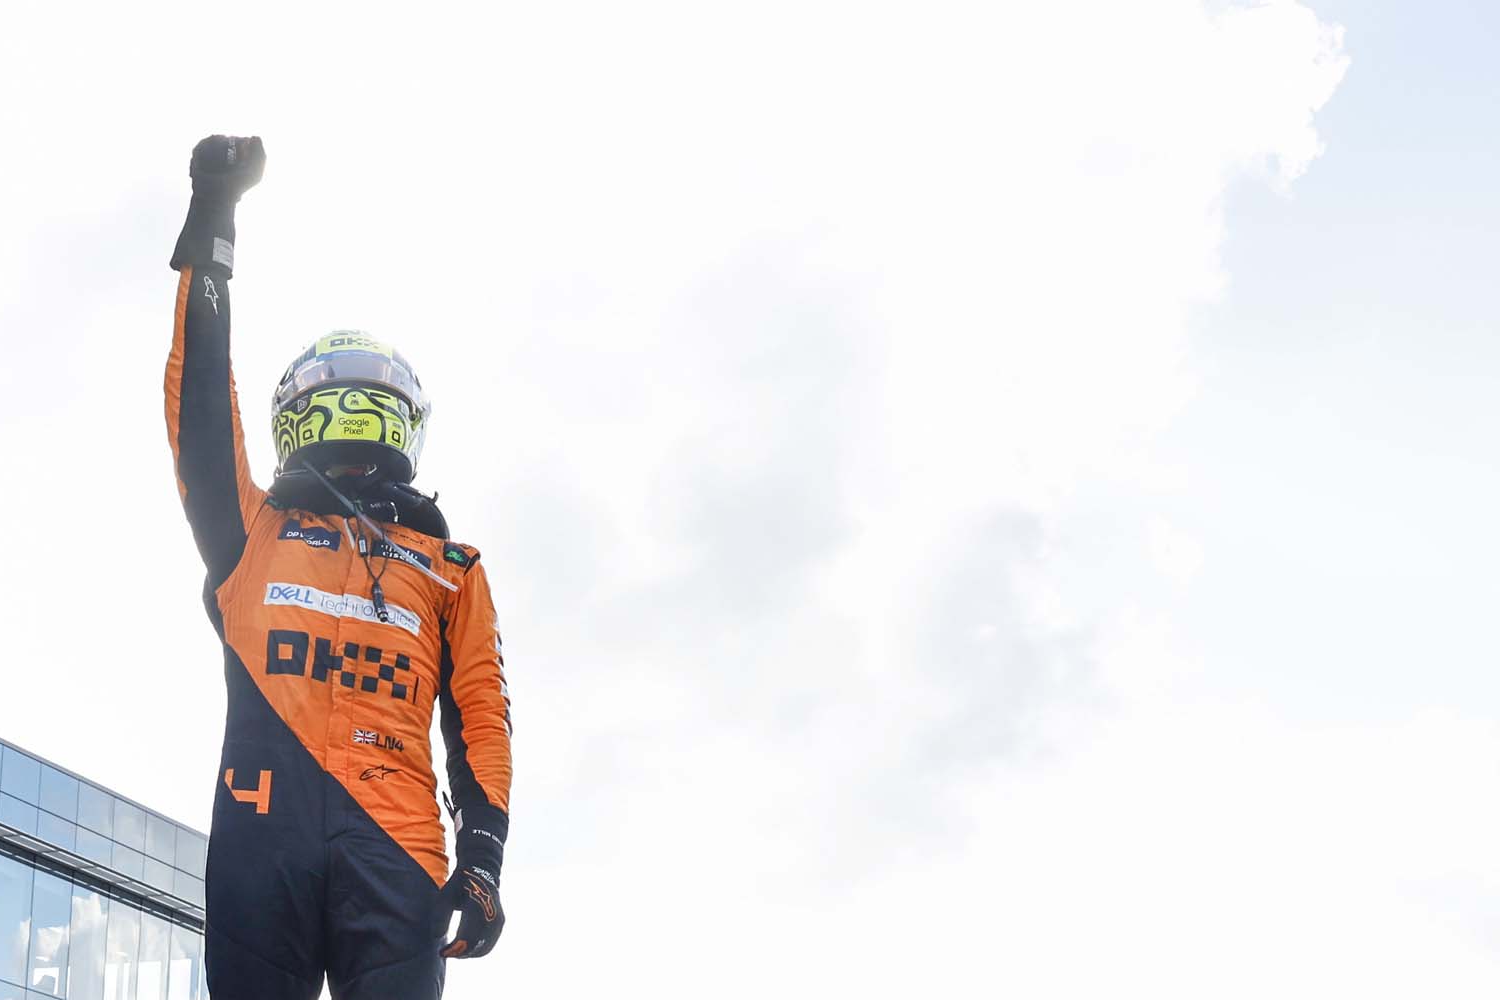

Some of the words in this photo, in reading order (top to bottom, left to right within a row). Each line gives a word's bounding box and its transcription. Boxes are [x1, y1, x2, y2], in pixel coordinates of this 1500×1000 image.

[338, 418, 369, 427] Google
[344, 427, 364, 435] Pixel
[382, 551, 409, 562] cisc
[269, 586, 313, 605] DELL
[266, 629, 411, 700] OKX
[376, 733, 404, 752] LN4
[224, 768, 272, 814] 4
